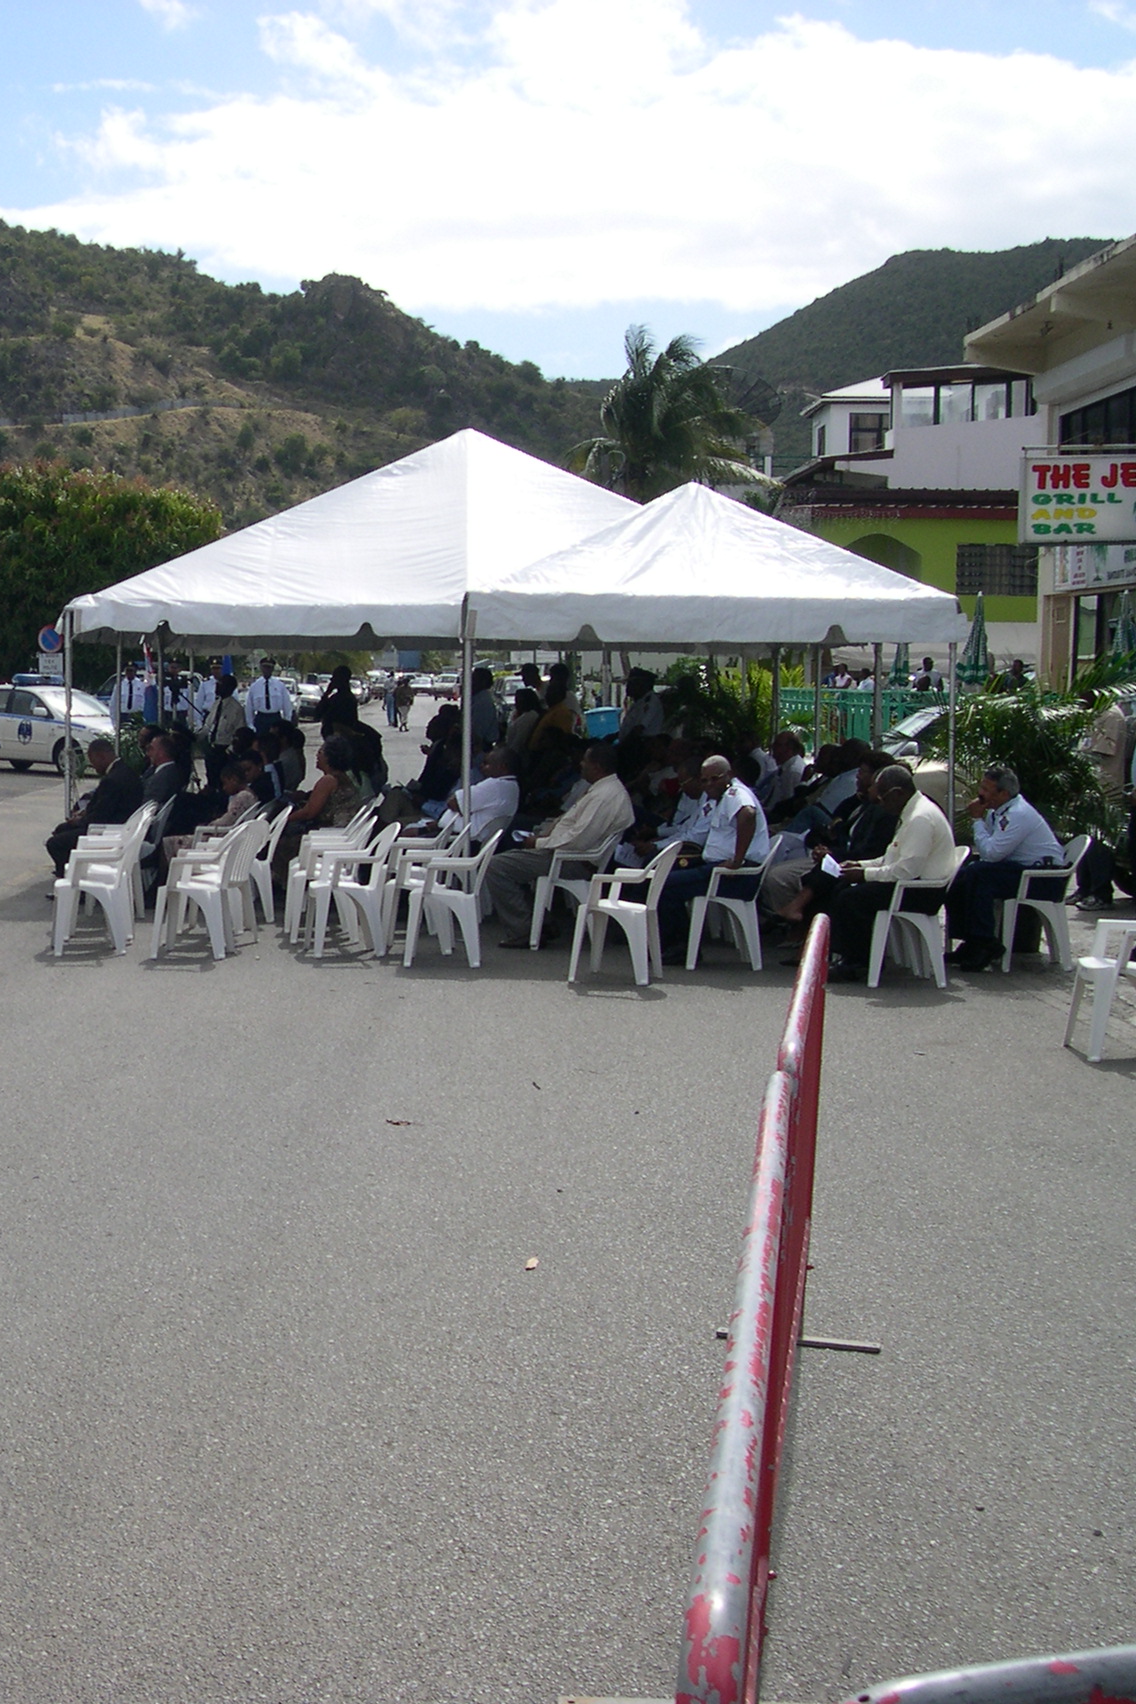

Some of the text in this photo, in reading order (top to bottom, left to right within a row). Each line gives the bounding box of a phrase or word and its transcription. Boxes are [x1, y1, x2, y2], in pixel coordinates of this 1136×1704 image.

[1032, 463, 1091, 490] THE
[1031, 492, 1123, 505] GRILL
[1031, 507, 1097, 520] AND
[1031, 522, 1097, 535] BAR
